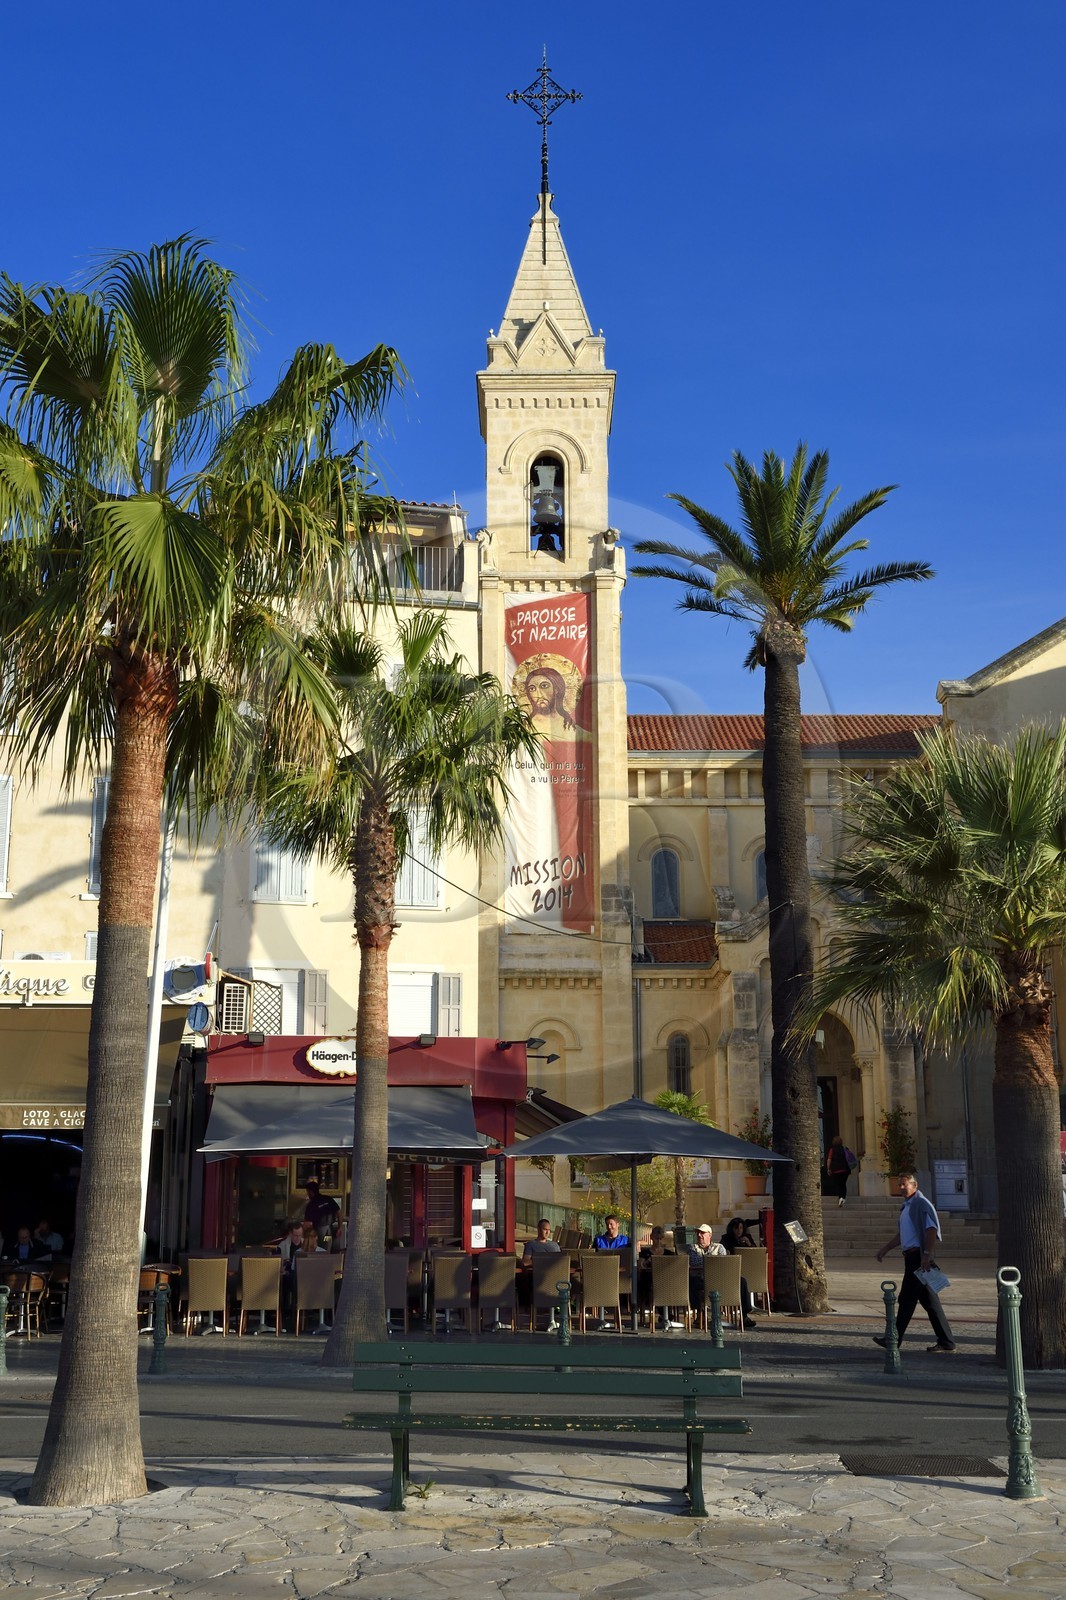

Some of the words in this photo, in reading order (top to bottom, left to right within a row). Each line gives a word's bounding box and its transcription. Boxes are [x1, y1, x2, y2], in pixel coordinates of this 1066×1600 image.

[517, 607, 576, 626] PAROISSE
[511, 628, 525, 646] ST
[529, 624, 588, 642] NAZAIRE
[540, 761, 554, 772] qui
[556, 760, 571, 770] m'a
[550, 775, 558, 783] le
[510, 853, 587, 887] MISSION
[532, 884, 573, 913] 2014
[23, 1110, 50, 1118] LOTO
[22, 1118, 50, 1126] CAVE
[53, 1118, 60, 1126] A
